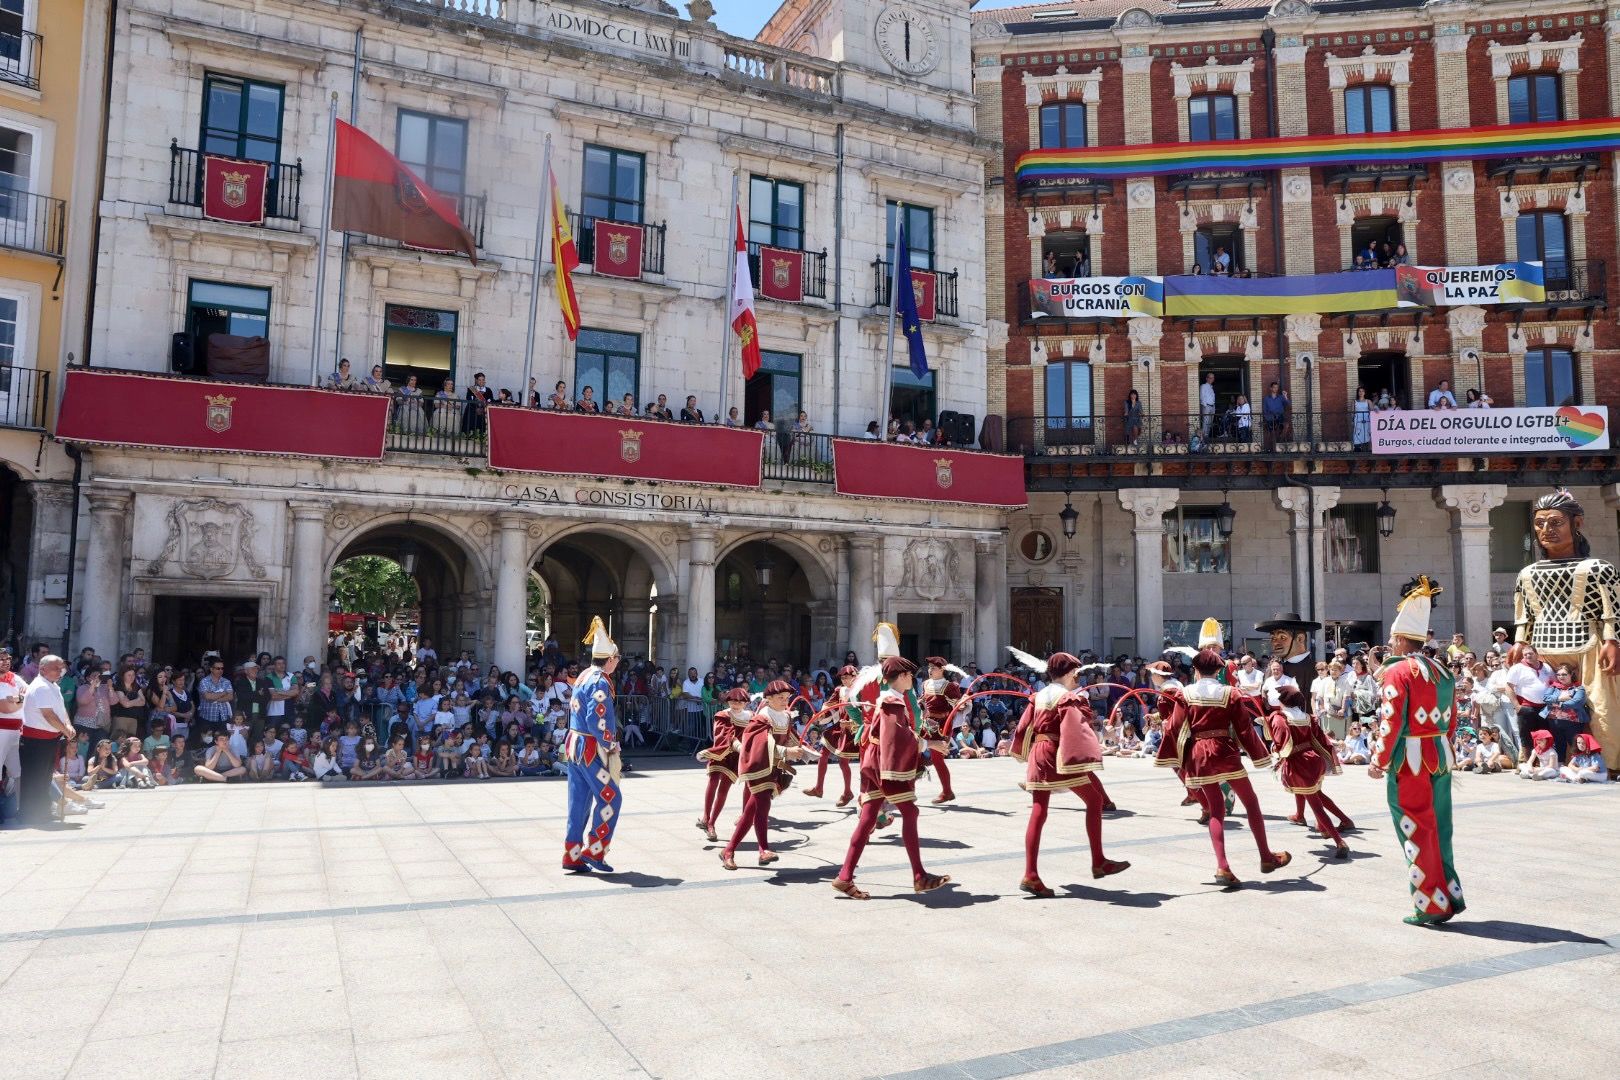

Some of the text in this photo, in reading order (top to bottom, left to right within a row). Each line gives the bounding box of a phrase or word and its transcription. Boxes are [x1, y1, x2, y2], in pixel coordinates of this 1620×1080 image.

[1426, 269, 1516, 284] QUEREMOS
[1050, 284, 1146, 296] BURGOS CON
[1445, 285, 1500, 298] LA PAZ
[1065, 298, 1131, 310] UCRANIA
[1377, 414, 1571, 431] DÍA DEL ORGULLO LGTBI+
[1378, 438, 1415, 447] Burgos,
[1416, 436, 1452, 446] ciudad
[1454, 436, 1500, 446] tolerante
[1509, 434, 1571, 445] integradora
[504, 484, 719, 511] CASA CONSISTORIAL
